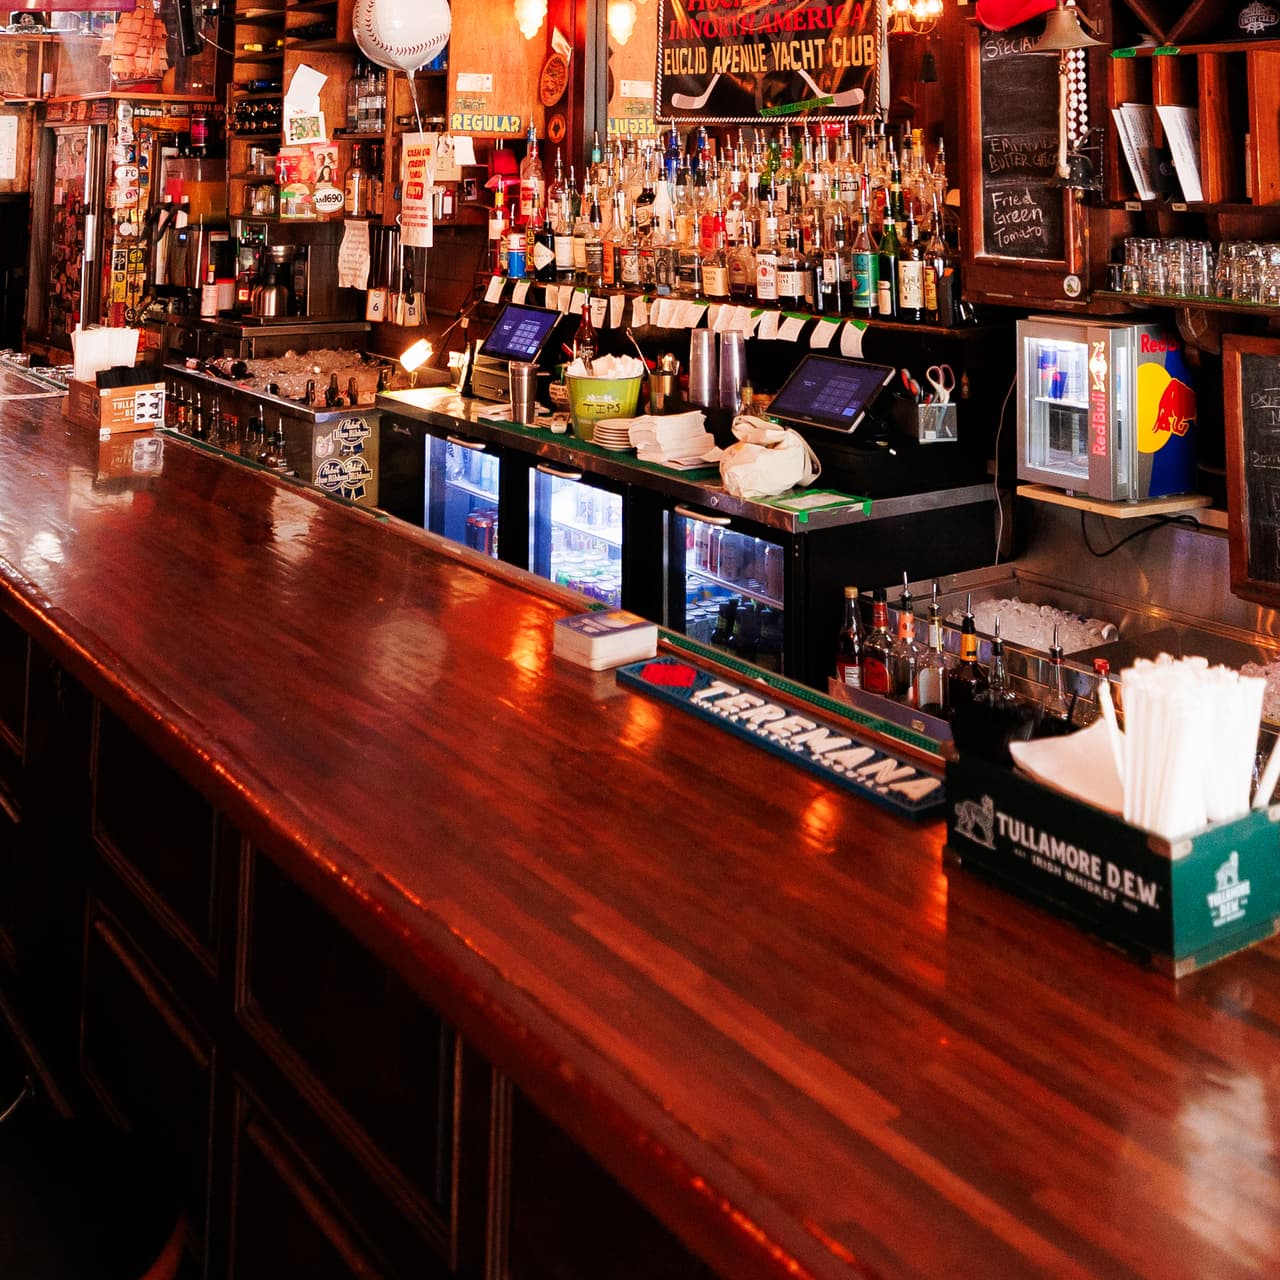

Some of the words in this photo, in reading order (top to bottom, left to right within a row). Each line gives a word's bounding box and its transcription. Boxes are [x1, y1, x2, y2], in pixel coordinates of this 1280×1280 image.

[670, 19, 690, 40] IN
[690, 13, 761, 39] NORTH
[761, 4, 867, 33] AMERICA
[664, 46, 707, 75] EUCLID
[711, 43, 768, 74] AVENUE
[771, 38, 826, 71] YACHT
[831, 34, 875, 68] CLUB
[452, 114, 520, 132] REGULAR
[992, 188, 1037, 210] Fried
[993, 208, 1043, 225] Green
[994, 227, 1042, 248] Tomato
[583, 403, 622, 414] TIPS
[690, 680, 942, 801] TEREMANA
[996, 811, 1103, 883] TULLAMORE
[1106, 862, 1160, 910] D.E.W.
[1032, 854, 1062, 877] IRISH
[1065, 868, 1117, 902] WHISKEY
